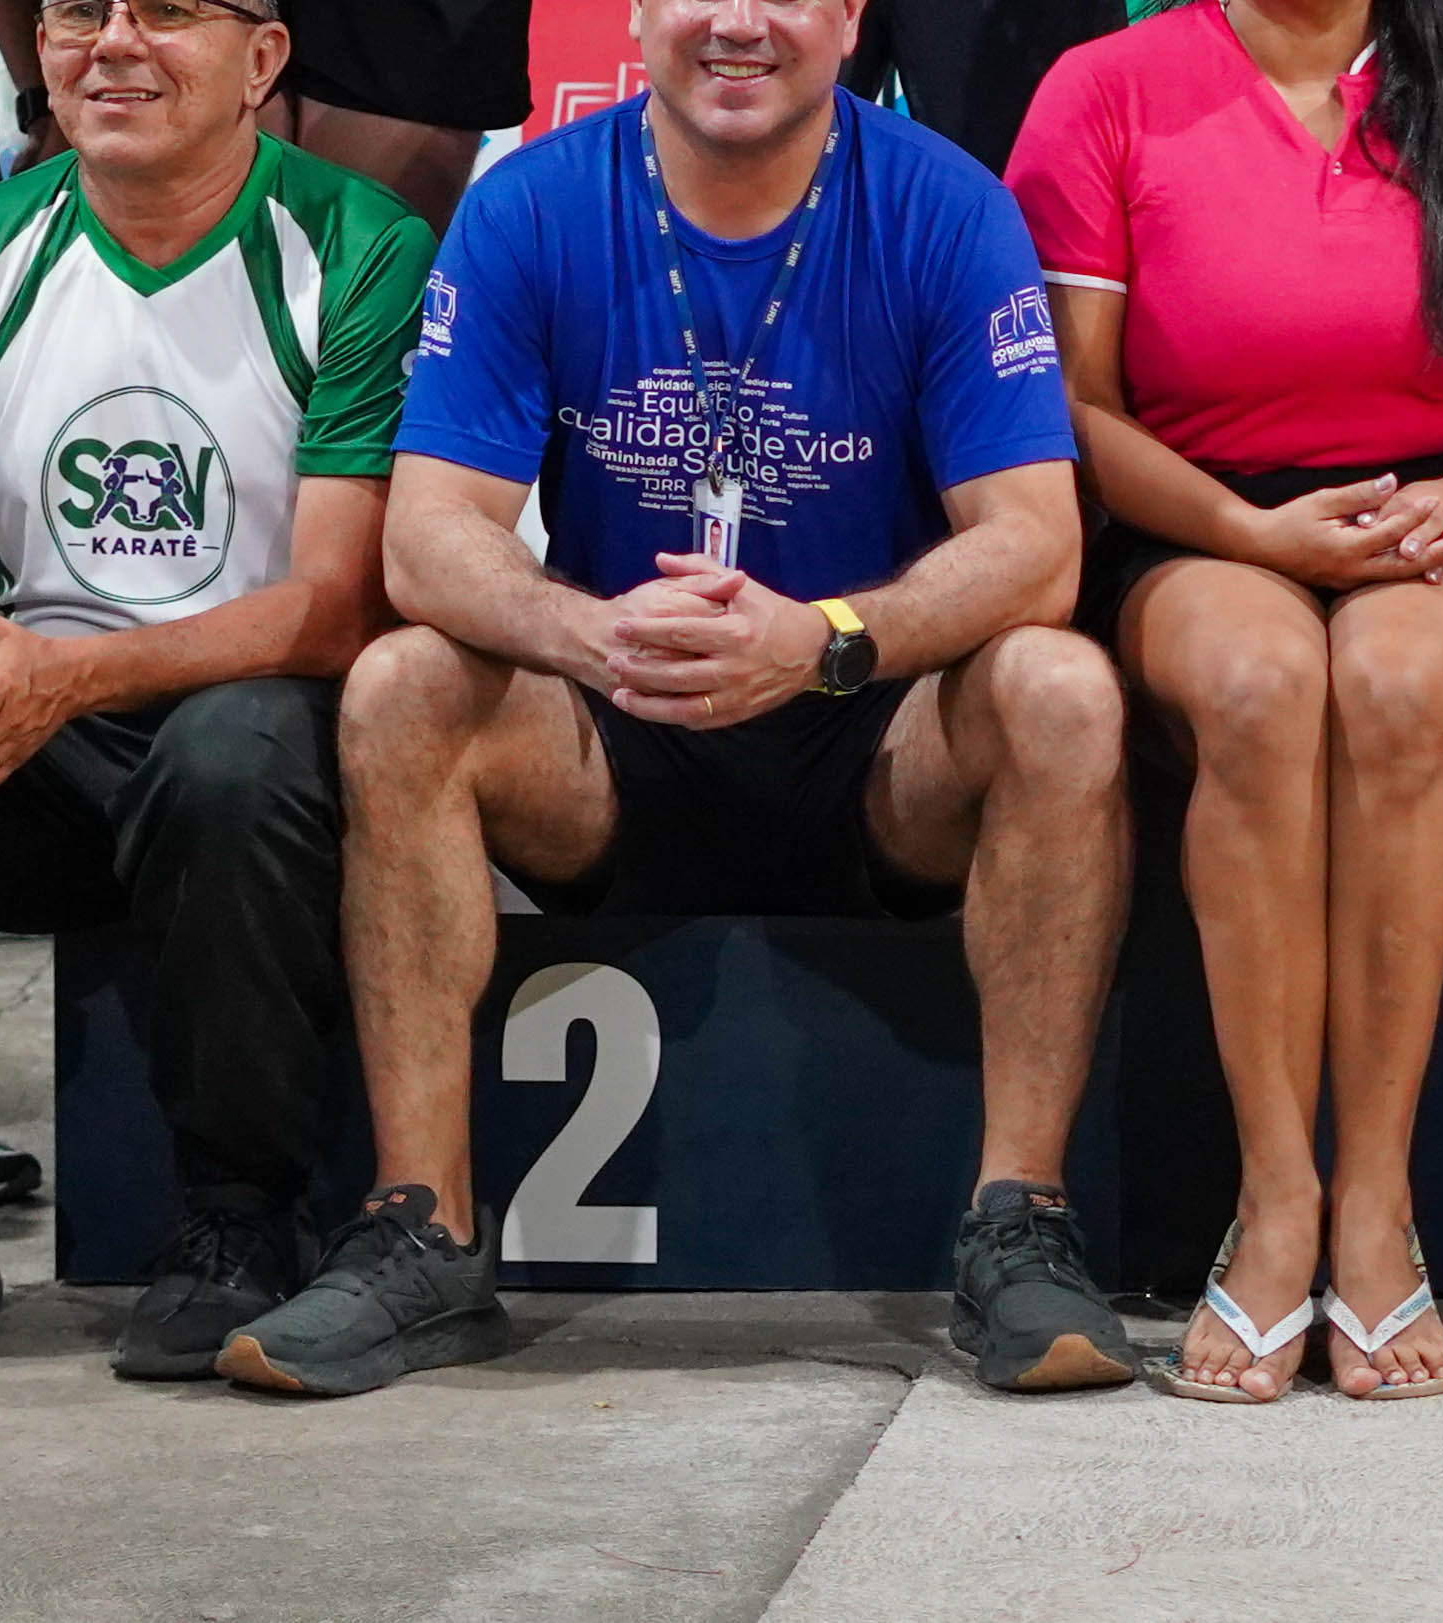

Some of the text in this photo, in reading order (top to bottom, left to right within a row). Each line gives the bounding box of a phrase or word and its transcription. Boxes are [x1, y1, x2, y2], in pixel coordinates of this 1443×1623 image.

[644, 155, 657, 178] TJRR
[656, 209, 670, 235] TJRR
[785, 242, 802, 267] TJRR
[668, 268, 682, 295] TJRR
[764, 300, 782, 325] TJRR
[683, 329, 696, 355] TJRR
[637, 379, 695, 392] atividade
[586, 444, 678, 467] caminhada
[742, 426, 785, 459] de
[796, 432, 873, 463] vida
[642, 478, 686, 492] TJRR
[91, 535, 198, 558] KARATÊ
[502, 962, 661, 1263] 2
